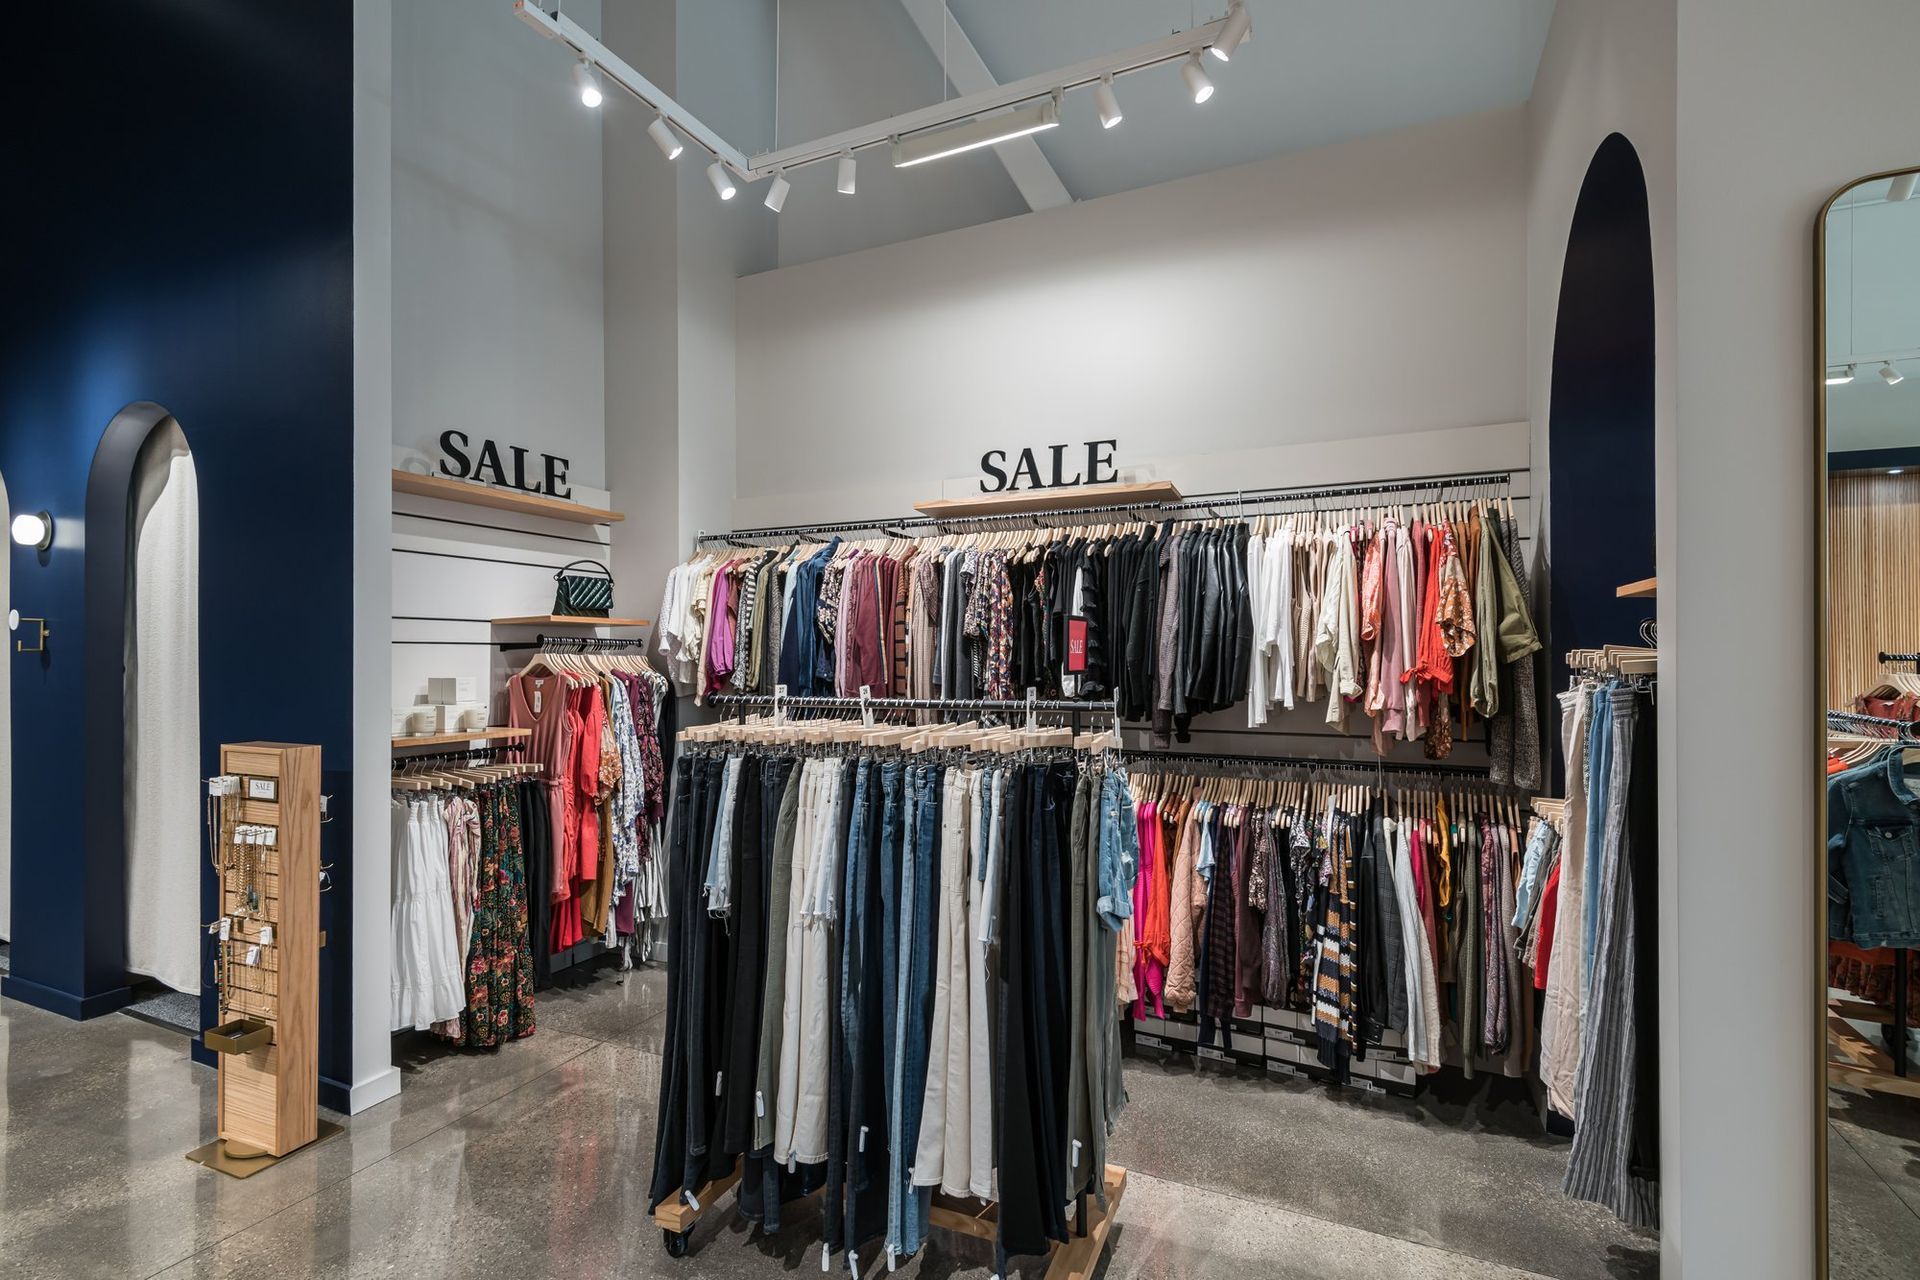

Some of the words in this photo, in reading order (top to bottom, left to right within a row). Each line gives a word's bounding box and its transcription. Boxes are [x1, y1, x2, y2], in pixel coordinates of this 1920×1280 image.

[440, 430, 571, 499] SALE
[981, 440, 1118, 492] SALE
[1070, 639, 1083, 654] SALE
[255, 782, 272, 791] SALE
